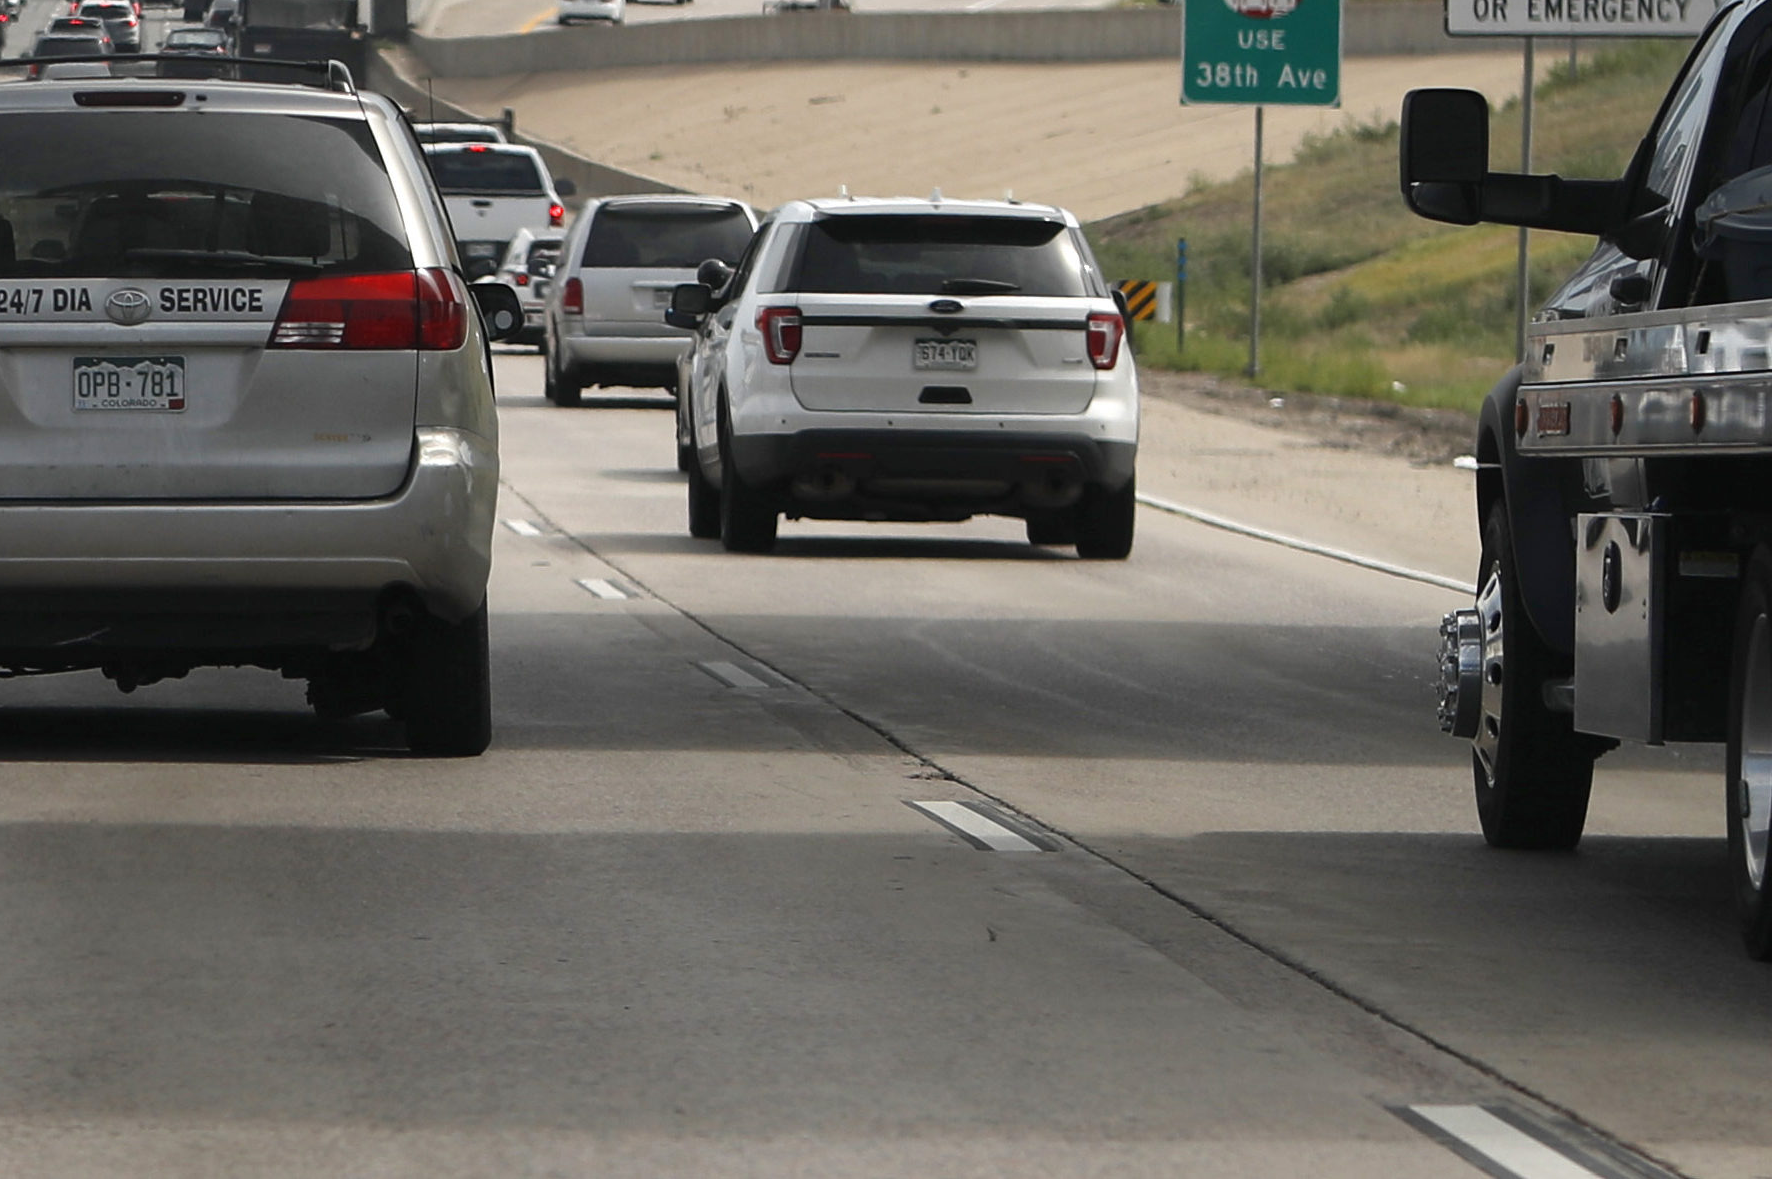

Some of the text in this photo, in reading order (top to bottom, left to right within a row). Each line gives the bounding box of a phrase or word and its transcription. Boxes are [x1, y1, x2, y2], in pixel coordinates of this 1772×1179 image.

[1237, 29, 1286, 50] USE
[1196, 62, 1328, 89] 38th Ave
[52, 287, 93, 313] DIA
[159, 287, 264, 313] SERVICE
[101, 398, 158, 408] COLORADO
